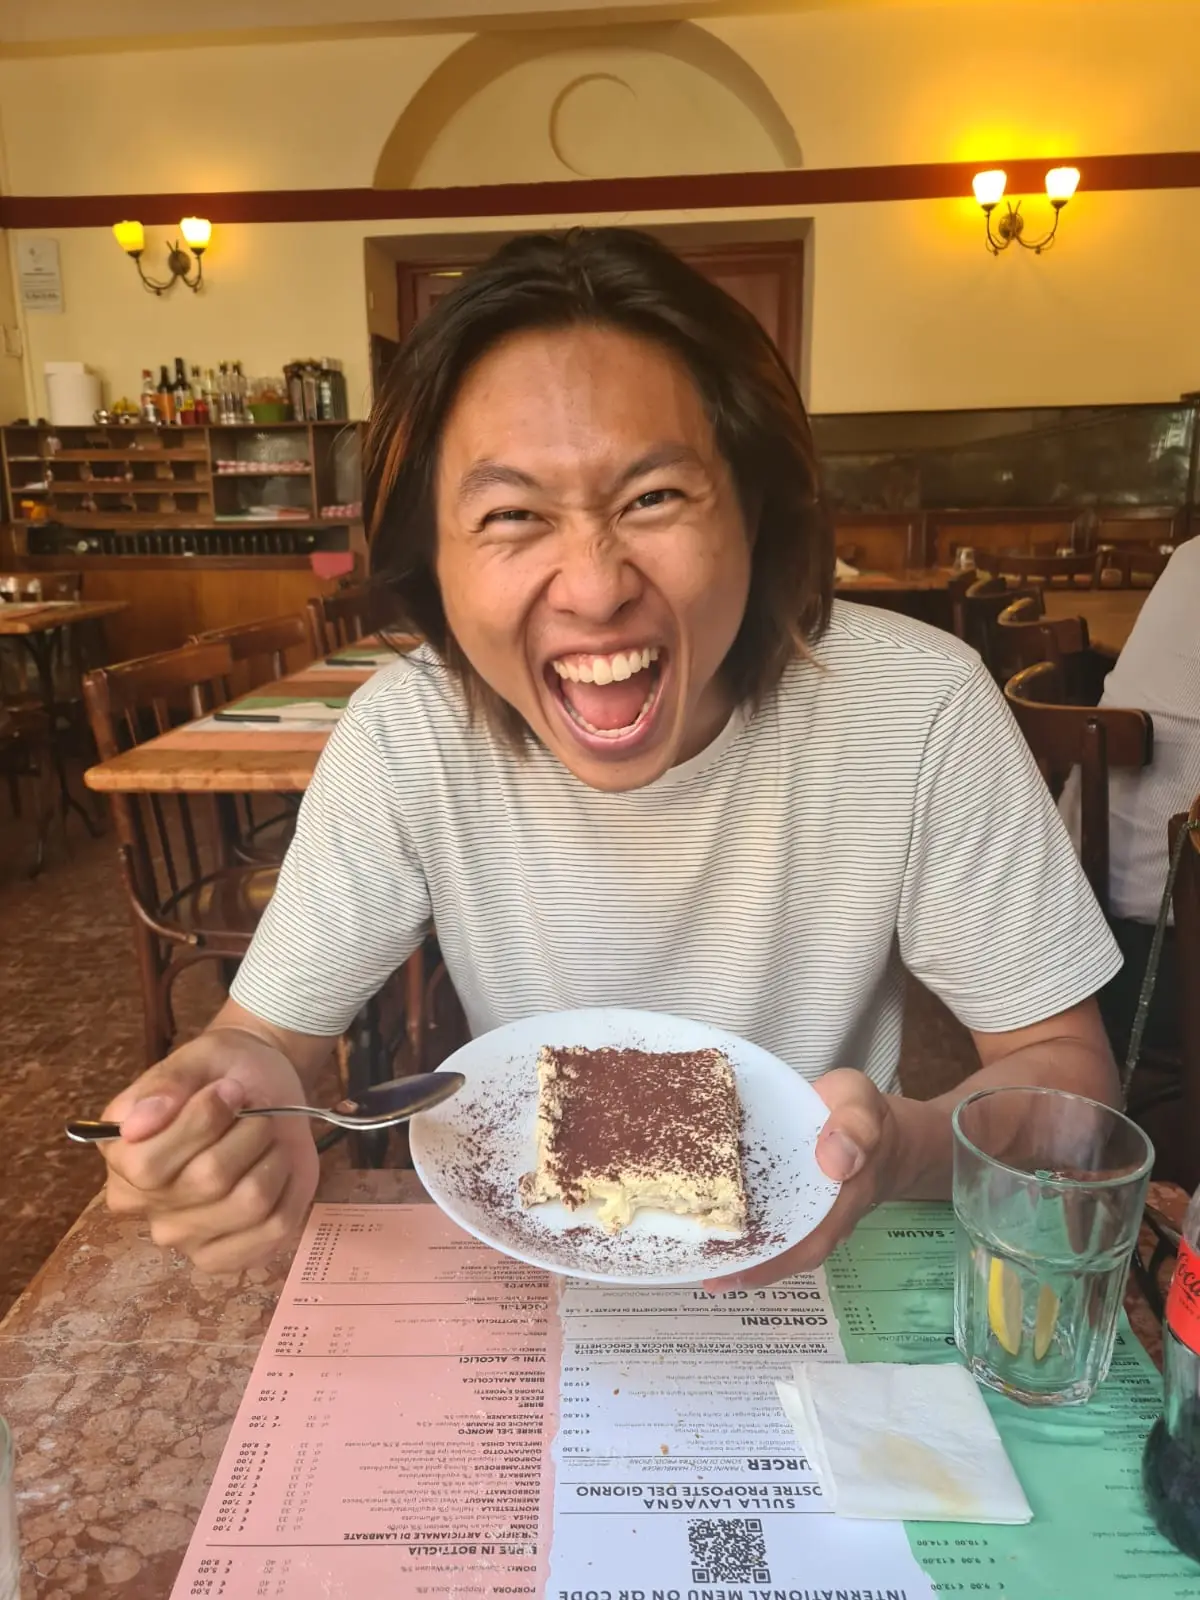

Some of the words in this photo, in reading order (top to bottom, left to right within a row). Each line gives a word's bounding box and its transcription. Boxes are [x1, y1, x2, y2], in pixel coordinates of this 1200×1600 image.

[772, 1292, 820, 1300] DOLCI
[741, 1317, 828, 1326] CONTORNI
[746, 1460, 812, 1470] URGER
[576, 1486, 643, 1496] GIORNO
[647, 1486, 677, 1496] DEL
[681, 1486, 768, 1496] PROPOSTE
[772, 1486, 822, 1496] OSTRE
[642, 1499, 732, 1509] LAVAGNA
[738, 1499, 796, 1509] SULLA
[408, 1546, 477, 1556] BOTTIGLIA
[481, 1546, 494, 1554] IN
[498, 1546, 537, 1554] BRRE
[558, 1591, 612, 1600] CODE
[618, 1591, 646, 1600] QR
[652, 1591, 680, 1600] ON
[687, 1591, 743, 1600] MENU
[748, 1591, 907, 1600] INTERNATIONAL
